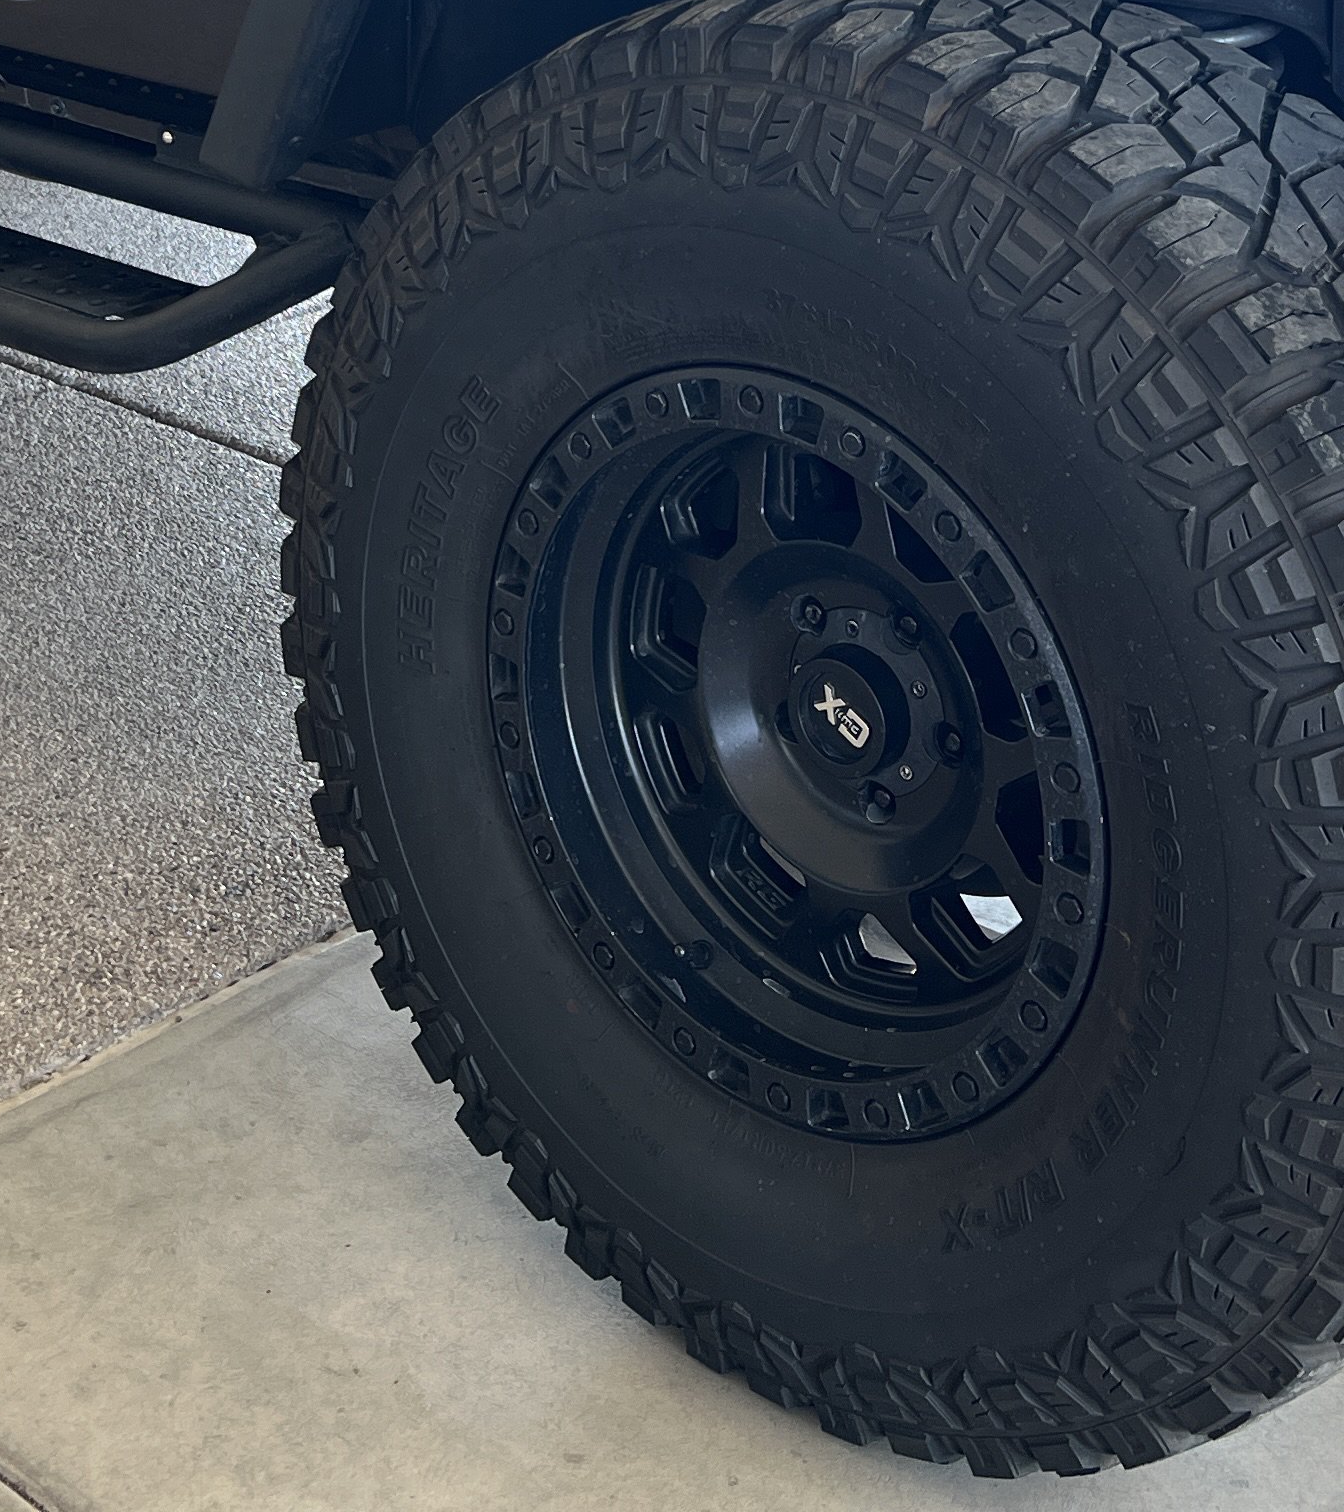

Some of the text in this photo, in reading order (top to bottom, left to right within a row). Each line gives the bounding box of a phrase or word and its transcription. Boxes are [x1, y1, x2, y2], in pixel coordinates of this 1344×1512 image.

[398, 373, 503, 676] HERITAGE
[813, 683, 871, 749] XD
[1069, 701, 1183, 1175] RIDGERUNNER
